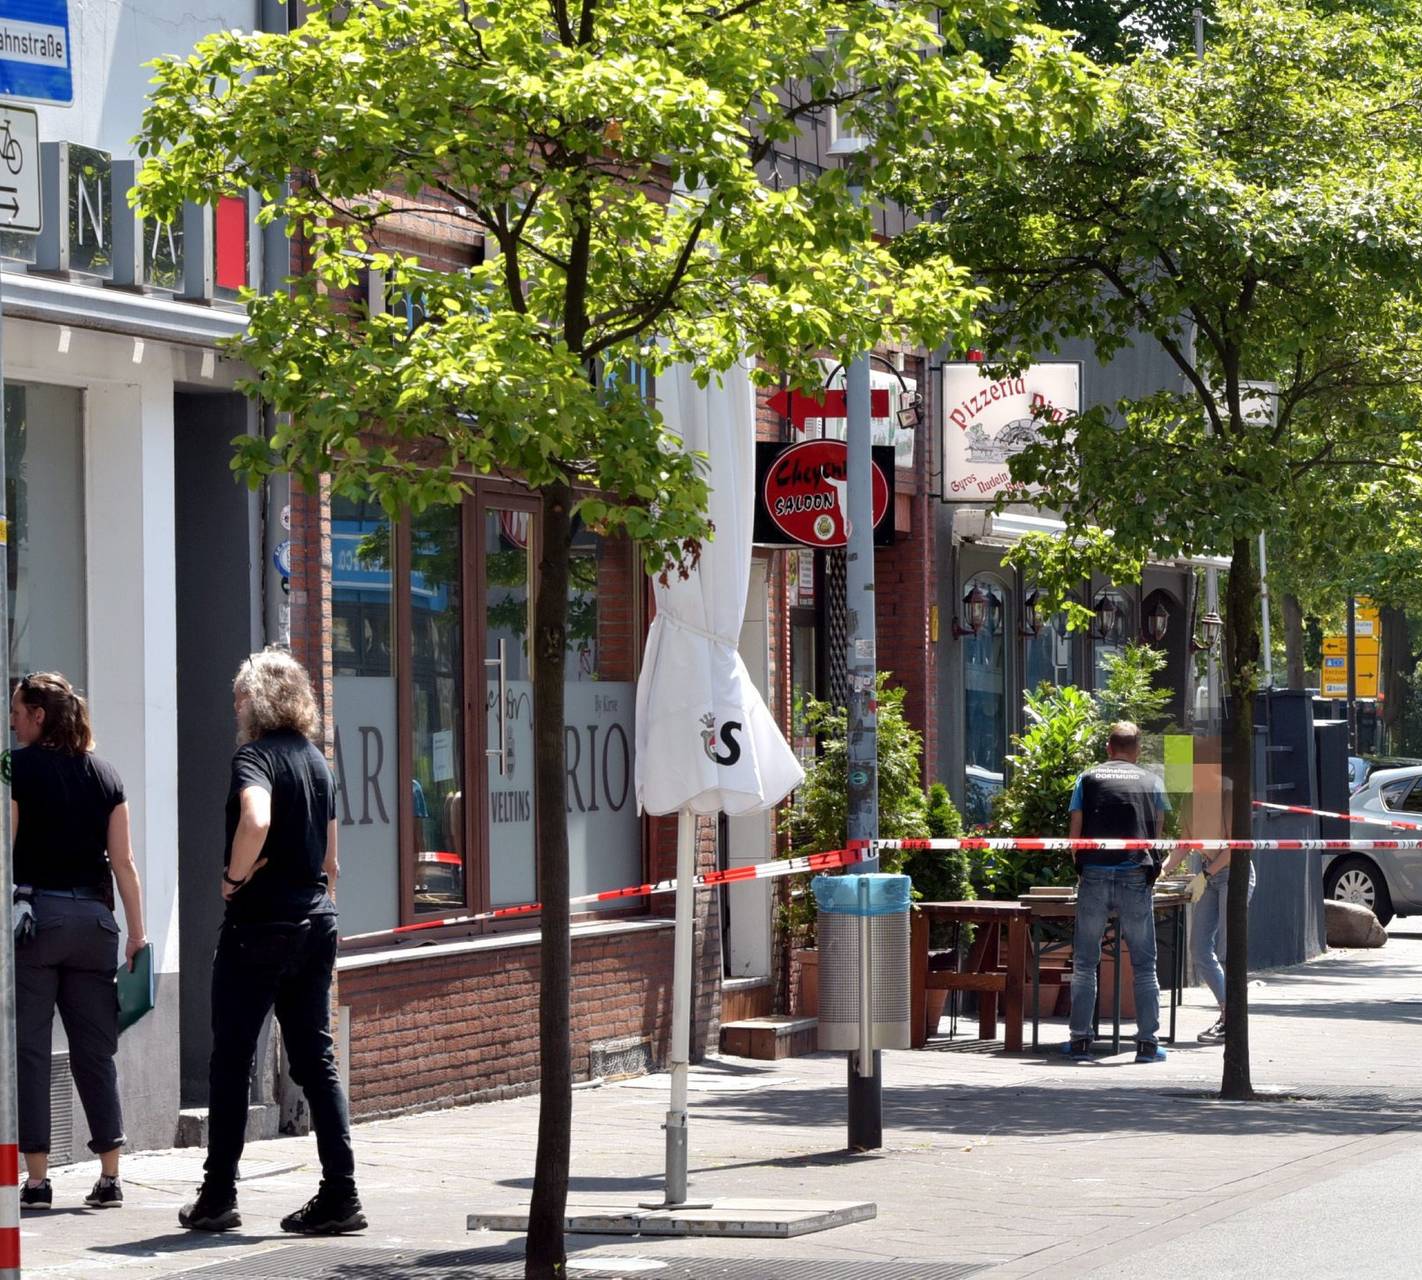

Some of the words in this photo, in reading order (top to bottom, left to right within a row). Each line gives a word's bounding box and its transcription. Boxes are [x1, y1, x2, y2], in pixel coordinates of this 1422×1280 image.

[949, 376, 1027, 431] Pizzeria
[951, 474, 977, 492] Gyros
[977, 472, 1009, 493] Nudeln
[775, 491, 835, 516] SALOON
[490, 790, 531, 824] VELTINS
